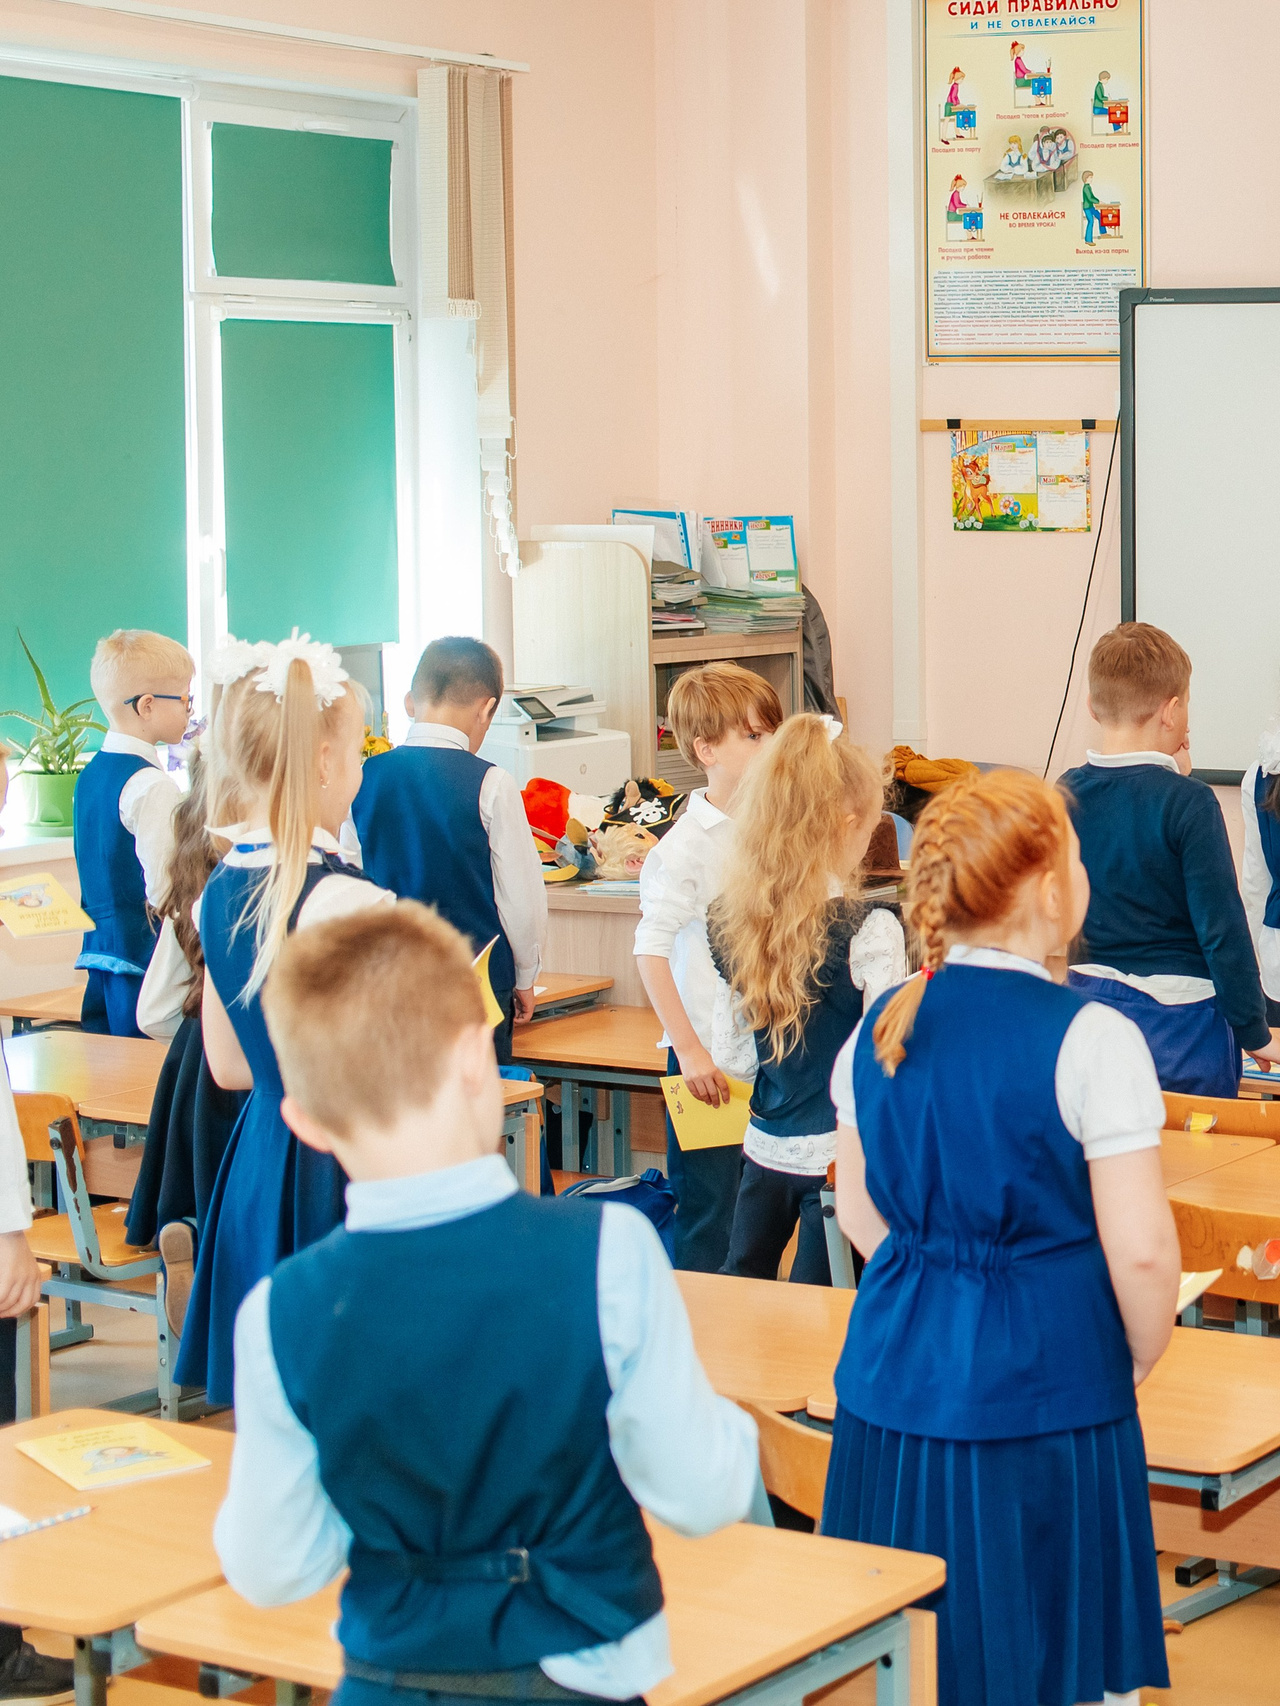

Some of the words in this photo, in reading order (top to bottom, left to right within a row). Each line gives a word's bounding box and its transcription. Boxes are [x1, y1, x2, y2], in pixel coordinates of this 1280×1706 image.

[948, 1, 998, 16] СИДИ
[1008, 0, 1118, 13] ПРАВИЛЬНО
[970, 21, 978, 30] И
[987, 20, 1002, 29] НЕ
[1011, 15, 1096, 28] ОТВЛЕКАЙСЯ
[999, 212, 1010, 220] НЕ
[1011, 209, 1066, 220] ОТВЛЕКАЙСЯ
